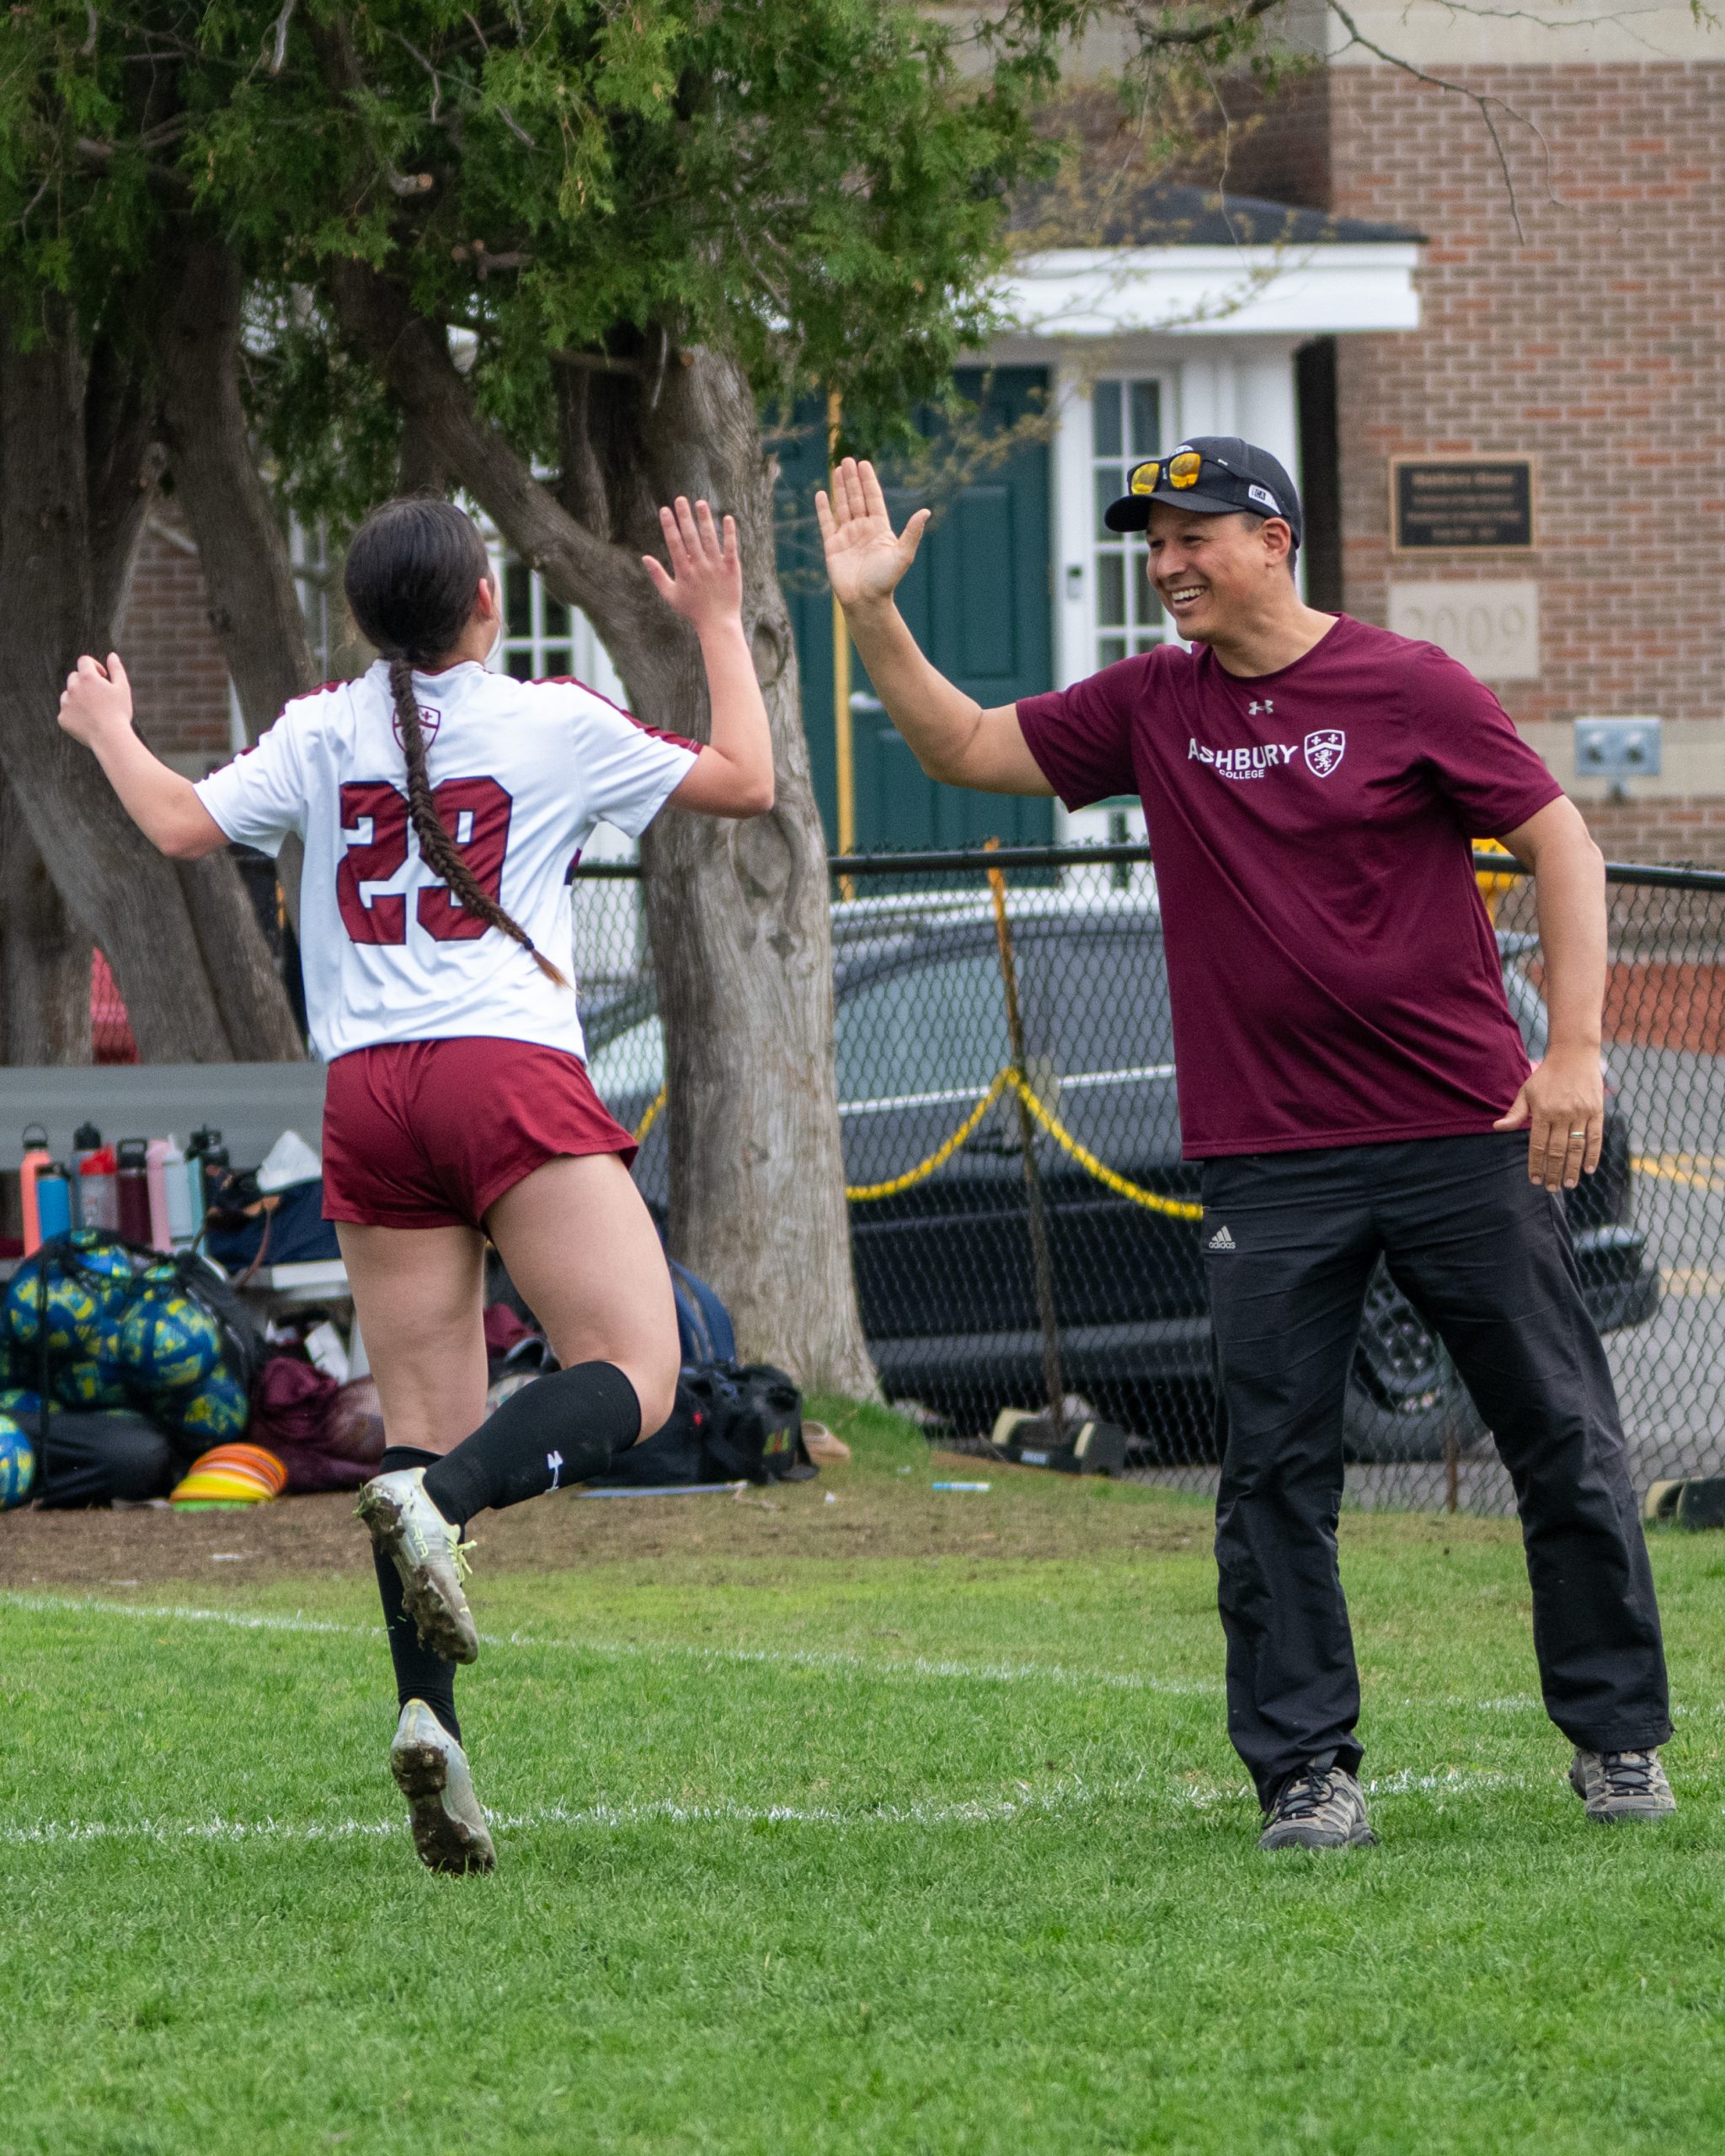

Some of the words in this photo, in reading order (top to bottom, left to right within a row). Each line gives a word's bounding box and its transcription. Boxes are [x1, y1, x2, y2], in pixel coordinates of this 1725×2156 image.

[1188, 738, 1298, 770] ASHBURY
[1219, 769, 1265, 779] COLLEGE
[337, 776, 513, 945] 29
